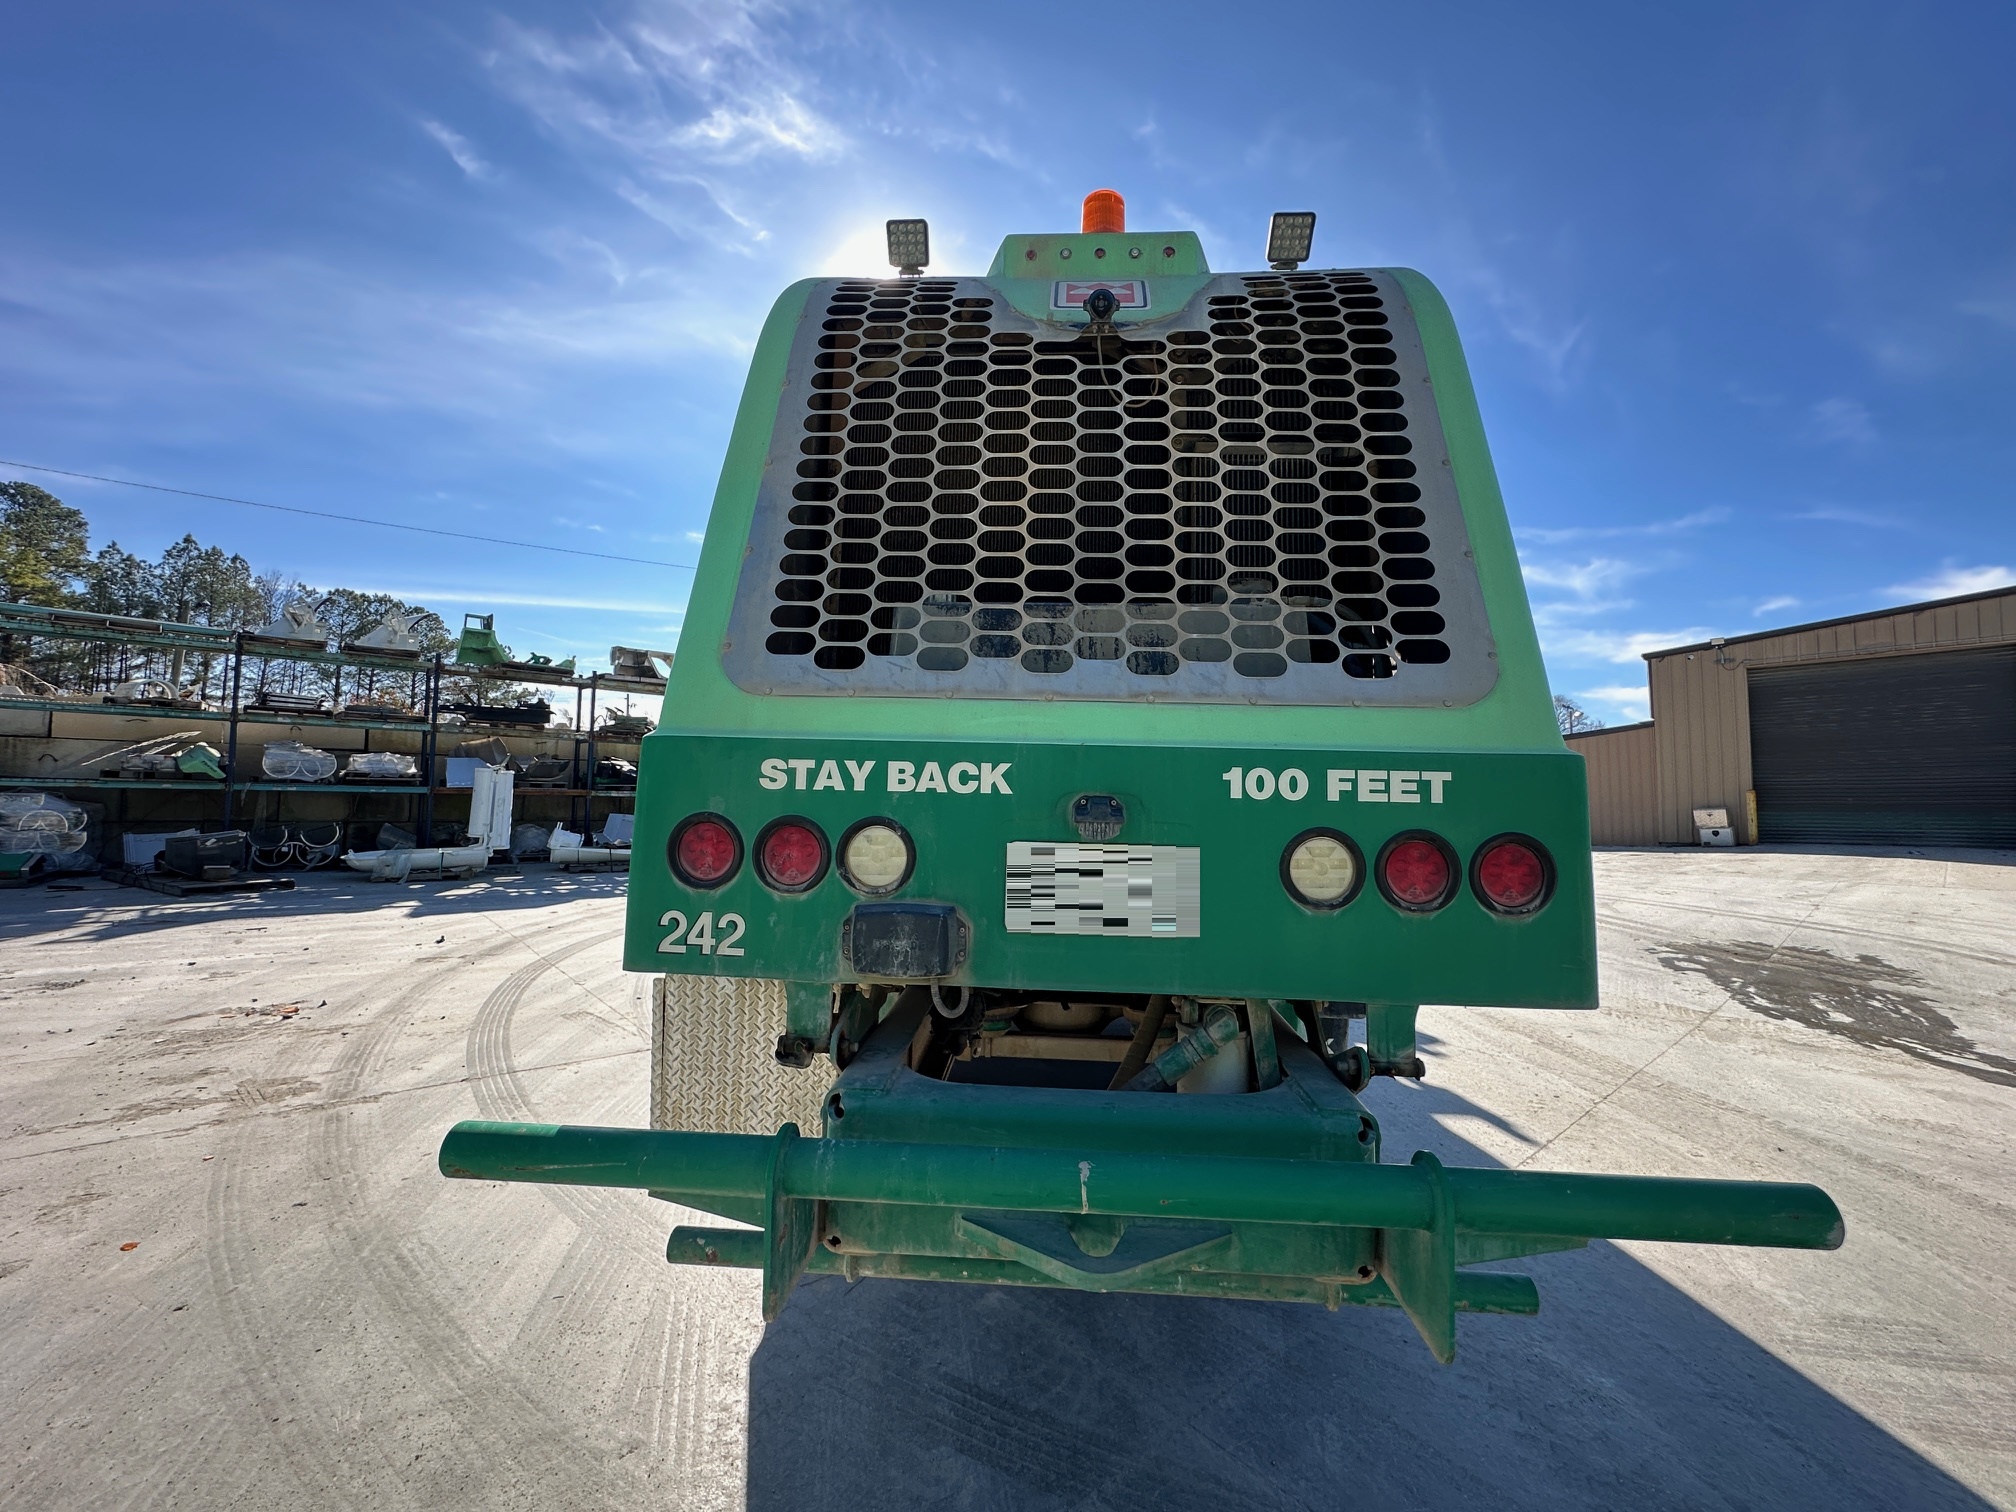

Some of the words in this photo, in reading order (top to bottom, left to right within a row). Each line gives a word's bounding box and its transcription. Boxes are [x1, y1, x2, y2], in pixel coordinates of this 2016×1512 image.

[758, 758, 877, 791] STAY
[886, 760, 1013, 795] BACK
[1222, 766, 1309, 801] 100
[1326, 769, 1452, 804] FEET
[658, 910, 746, 957] 242
